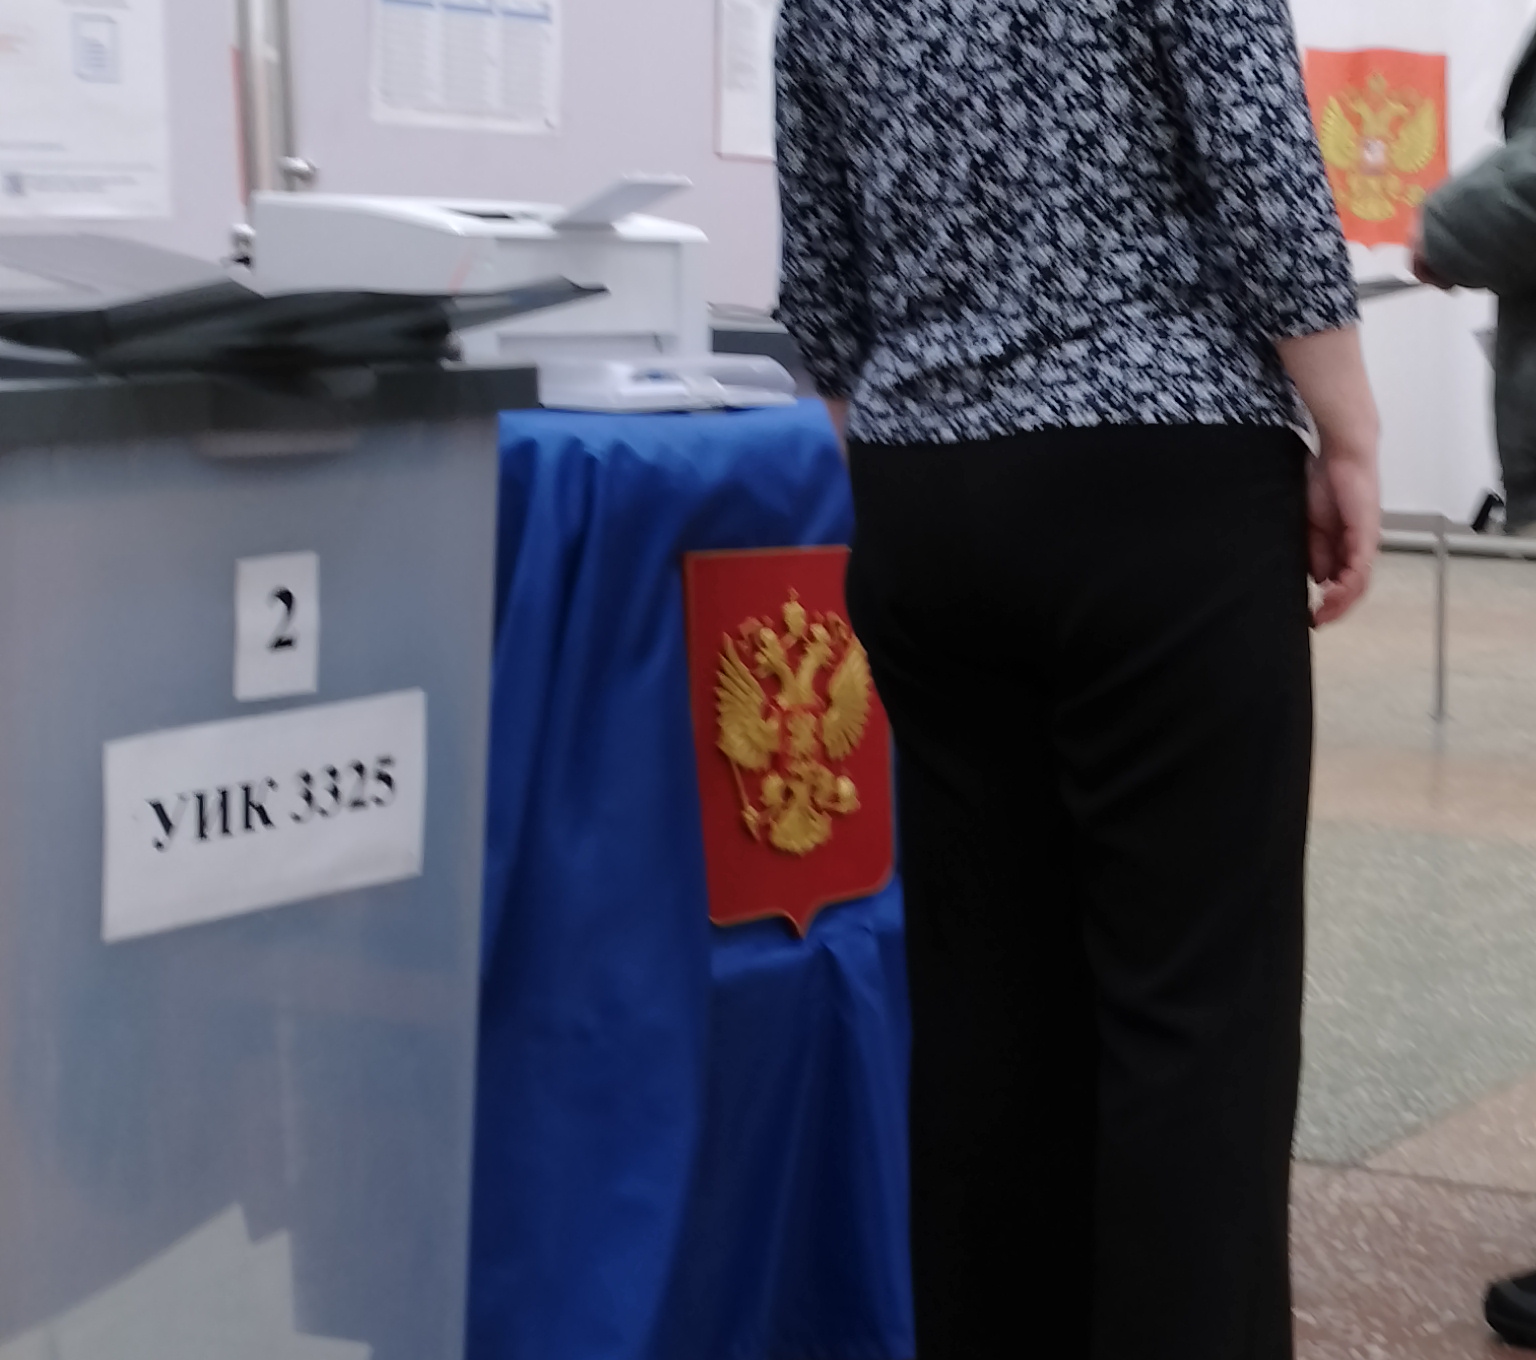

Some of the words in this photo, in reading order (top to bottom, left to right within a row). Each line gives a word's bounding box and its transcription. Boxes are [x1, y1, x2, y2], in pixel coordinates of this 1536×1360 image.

[268, 586, 298, 653] 2
[144, 777, 278, 853] УИК
[290, 754, 396, 823] 3325
